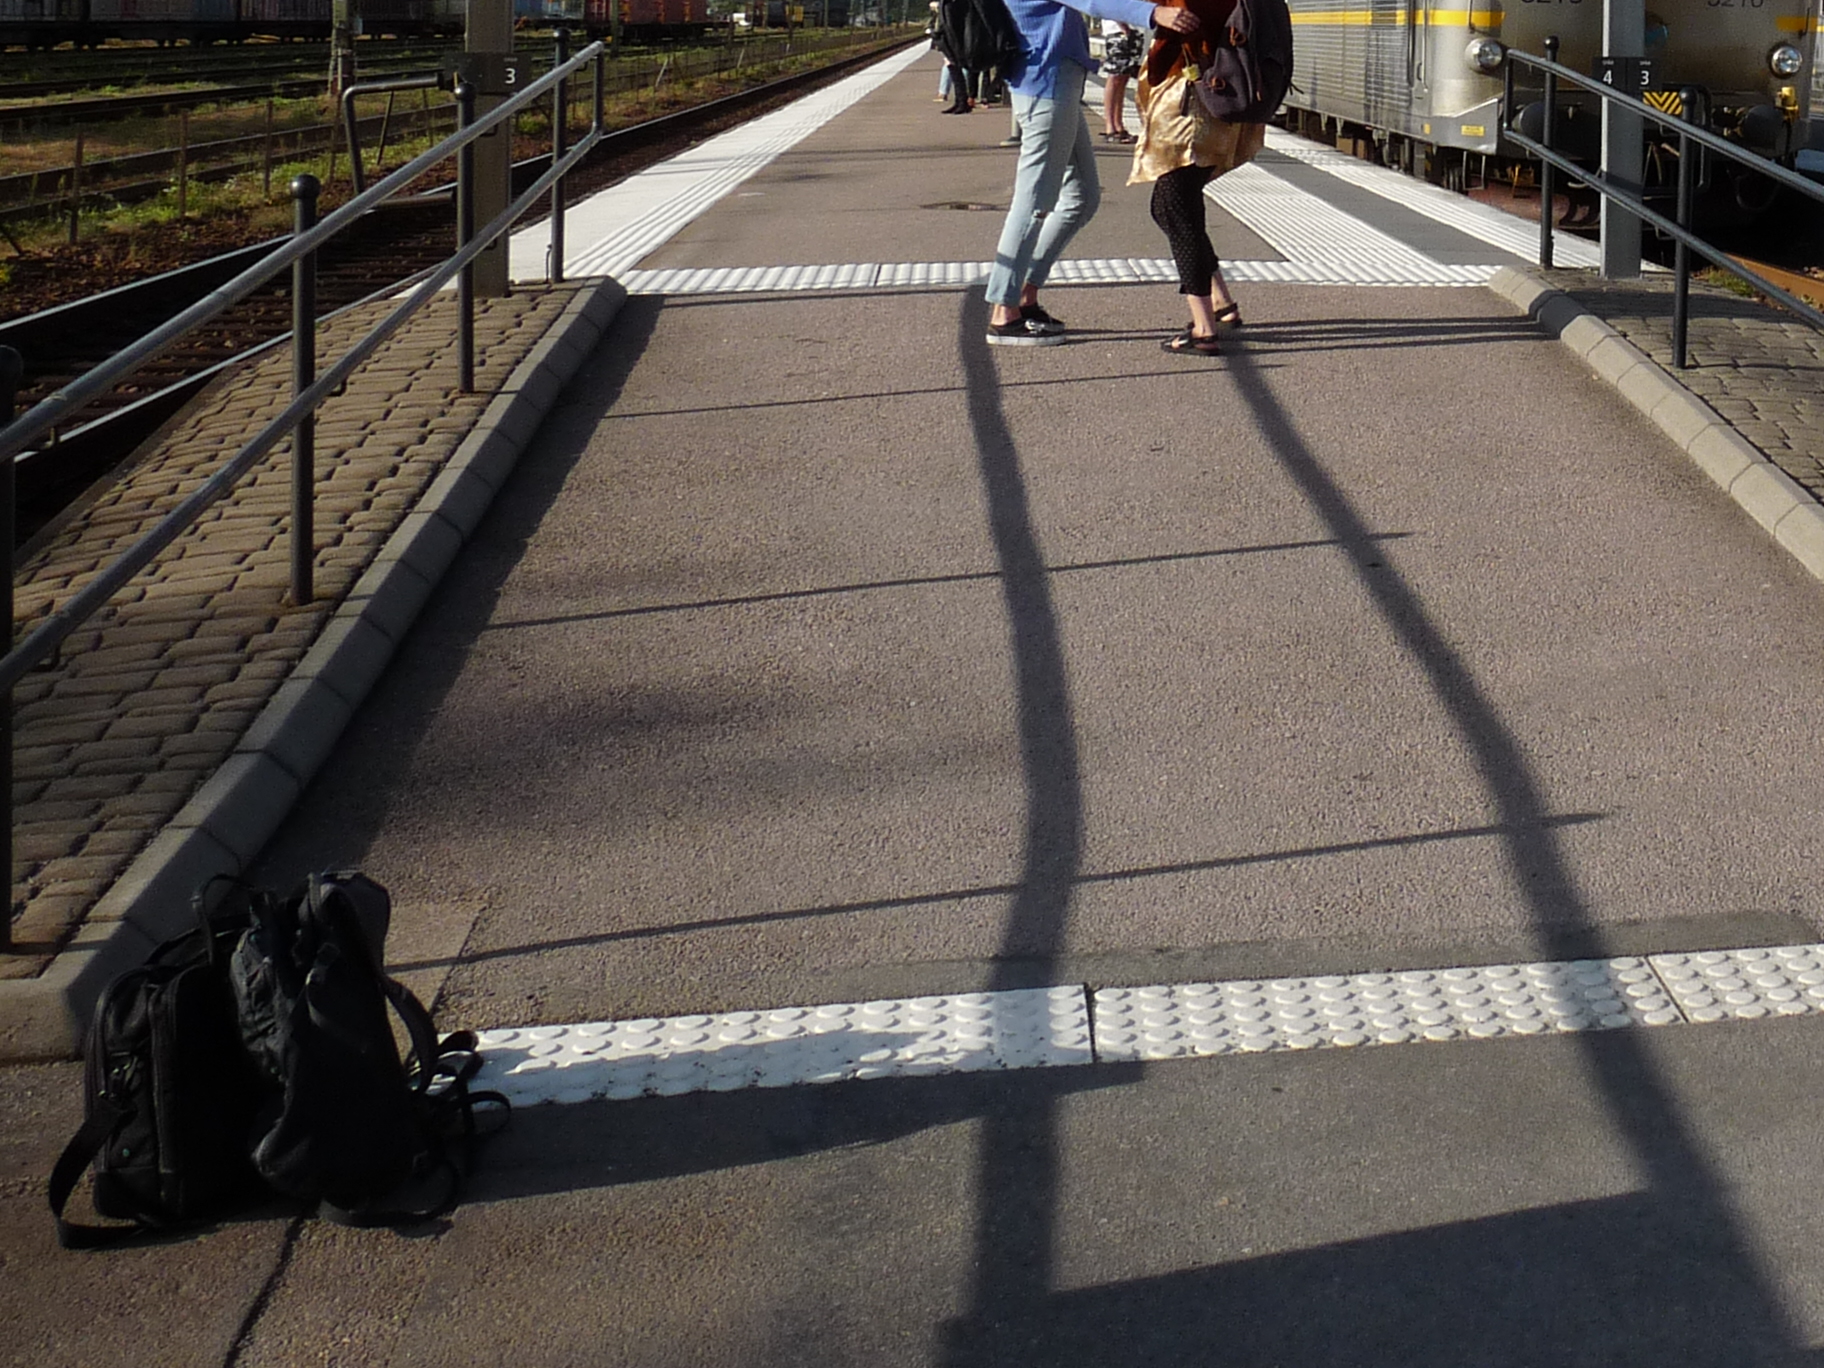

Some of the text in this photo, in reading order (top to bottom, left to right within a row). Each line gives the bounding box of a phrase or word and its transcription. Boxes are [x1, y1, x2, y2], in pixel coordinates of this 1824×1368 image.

[505, 67, 516, 84] 3
[1603, 69, 1612, 85] 4
[1640, 70, 1650, 85] 3
